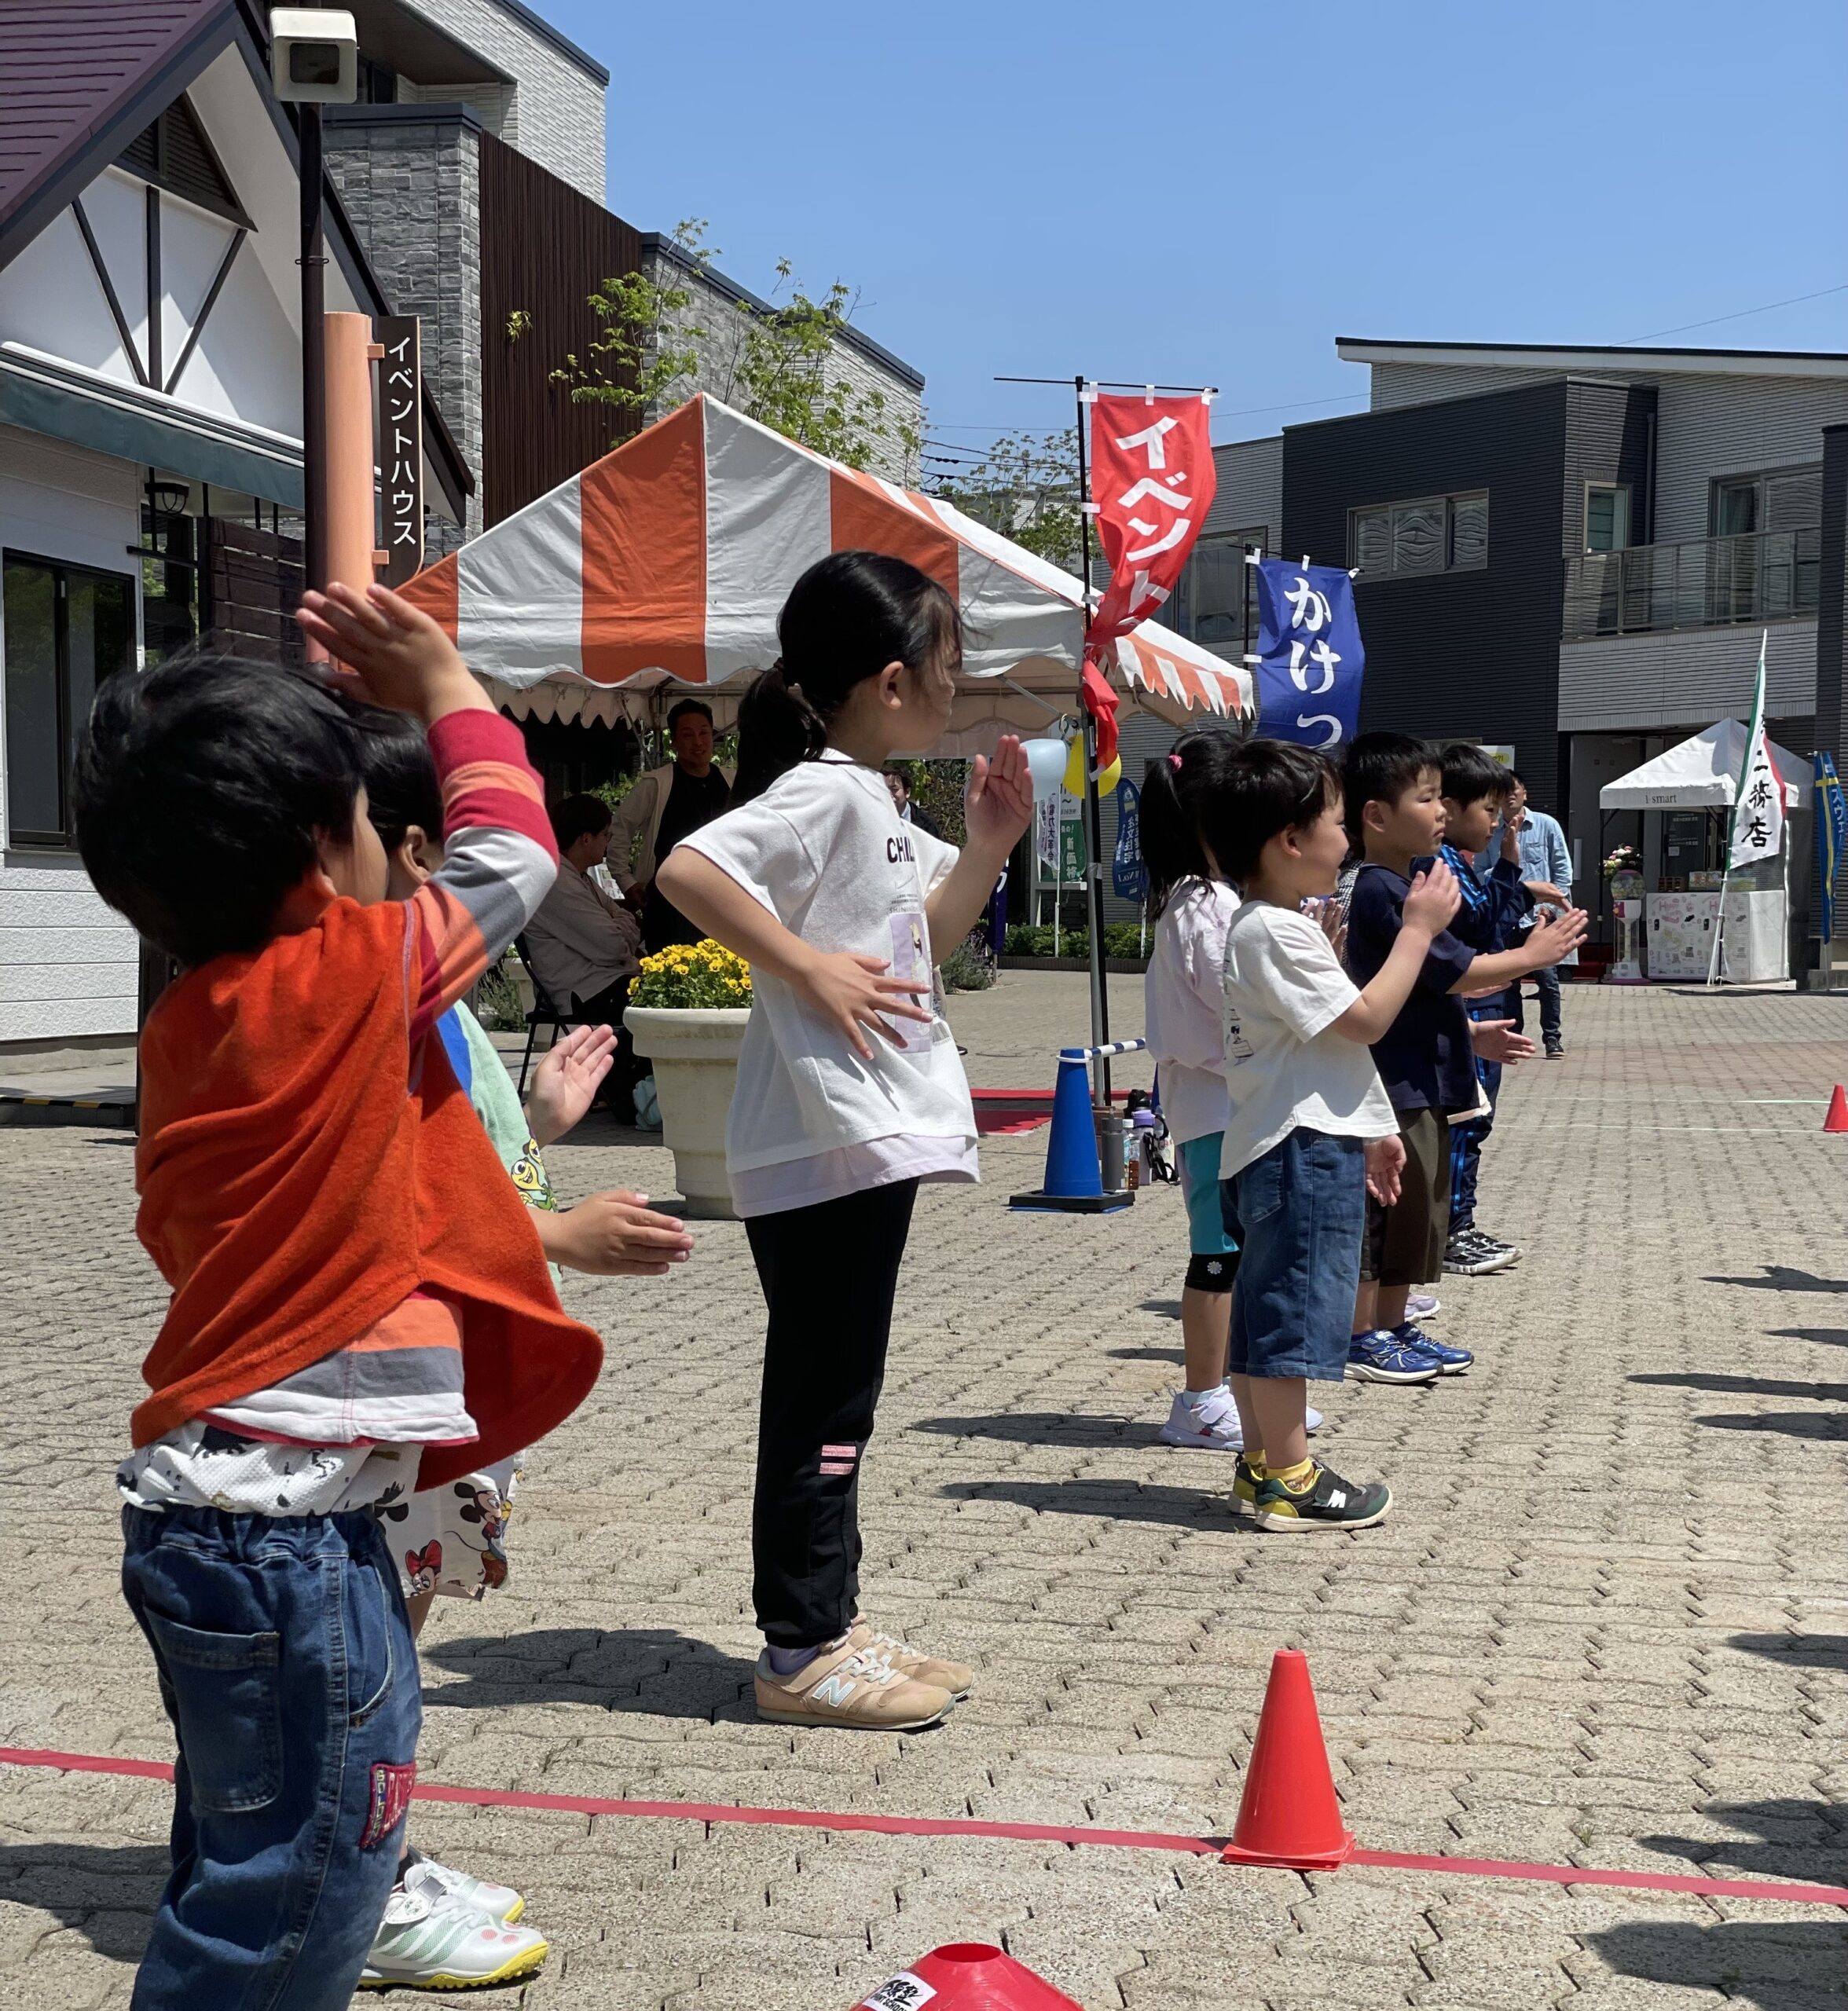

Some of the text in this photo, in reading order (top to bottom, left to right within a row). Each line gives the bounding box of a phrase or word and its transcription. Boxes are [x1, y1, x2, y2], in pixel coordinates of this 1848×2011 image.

[388, 336, 416, 545] イベントハウス
[1115, 416, 1193, 614] イベント
[1652, 793, 1678, 804] smart
[812, 1674, 858, 1708] N
